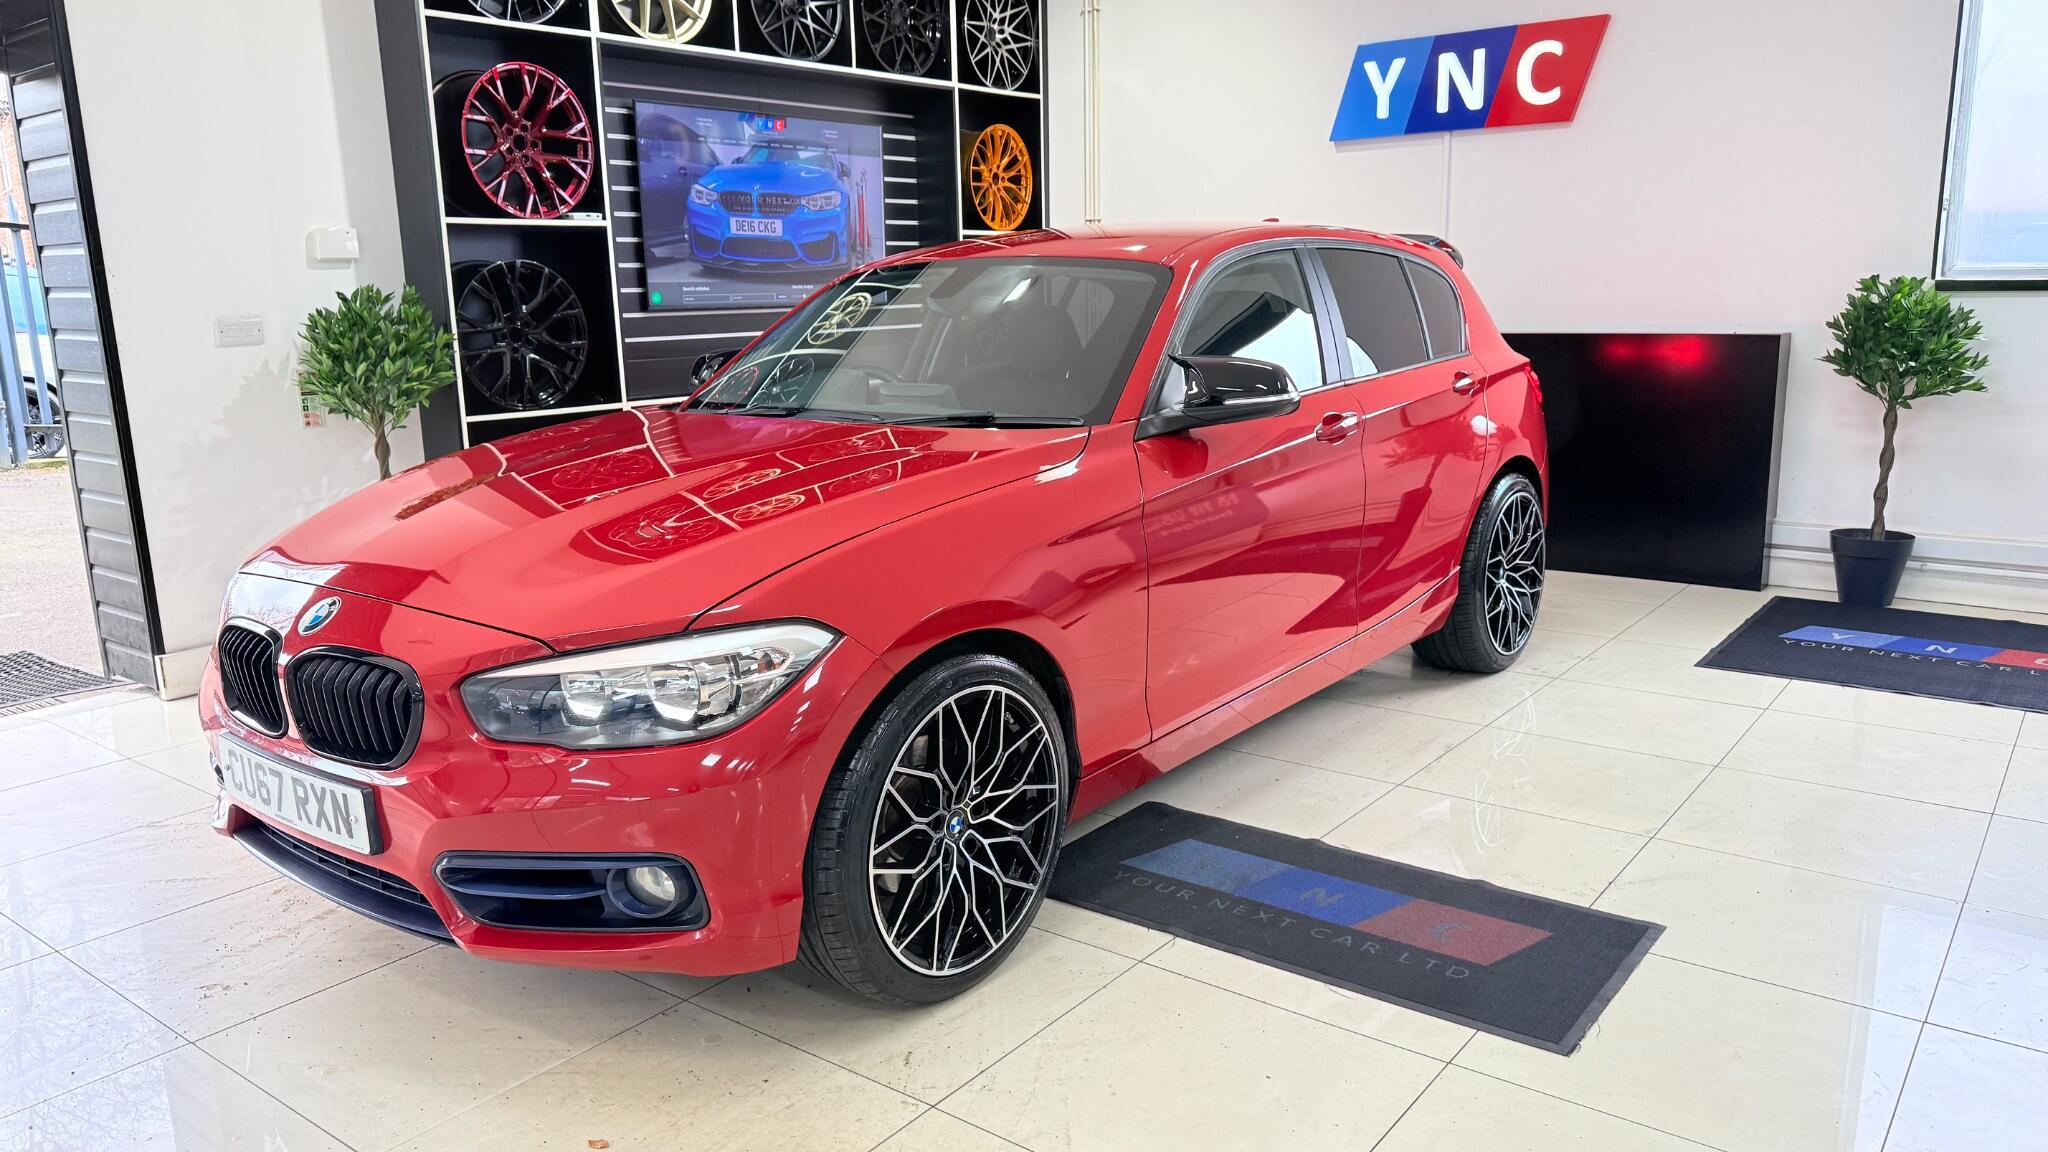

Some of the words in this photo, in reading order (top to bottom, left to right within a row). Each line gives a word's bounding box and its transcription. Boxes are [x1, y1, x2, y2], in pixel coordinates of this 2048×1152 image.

[1363, 39, 1563, 120] YNC
[735, 219, 756, 232] DE16
[757, 220, 777, 234] CKG
[1782, 638, 1855, 652] YOUR
[1869, 649, 1942, 663] NEXT
[1956, 660, 2014, 672] CAR
[227, 749, 284, 812] CU67
[290, 775, 354, 840] RXN
[1113, 870, 1196, 901] YOUR
[1208, 897, 1298, 928] NEXT
[1309, 927, 1382, 954] CAR
[1397, 952, 1470, 979] LTD
